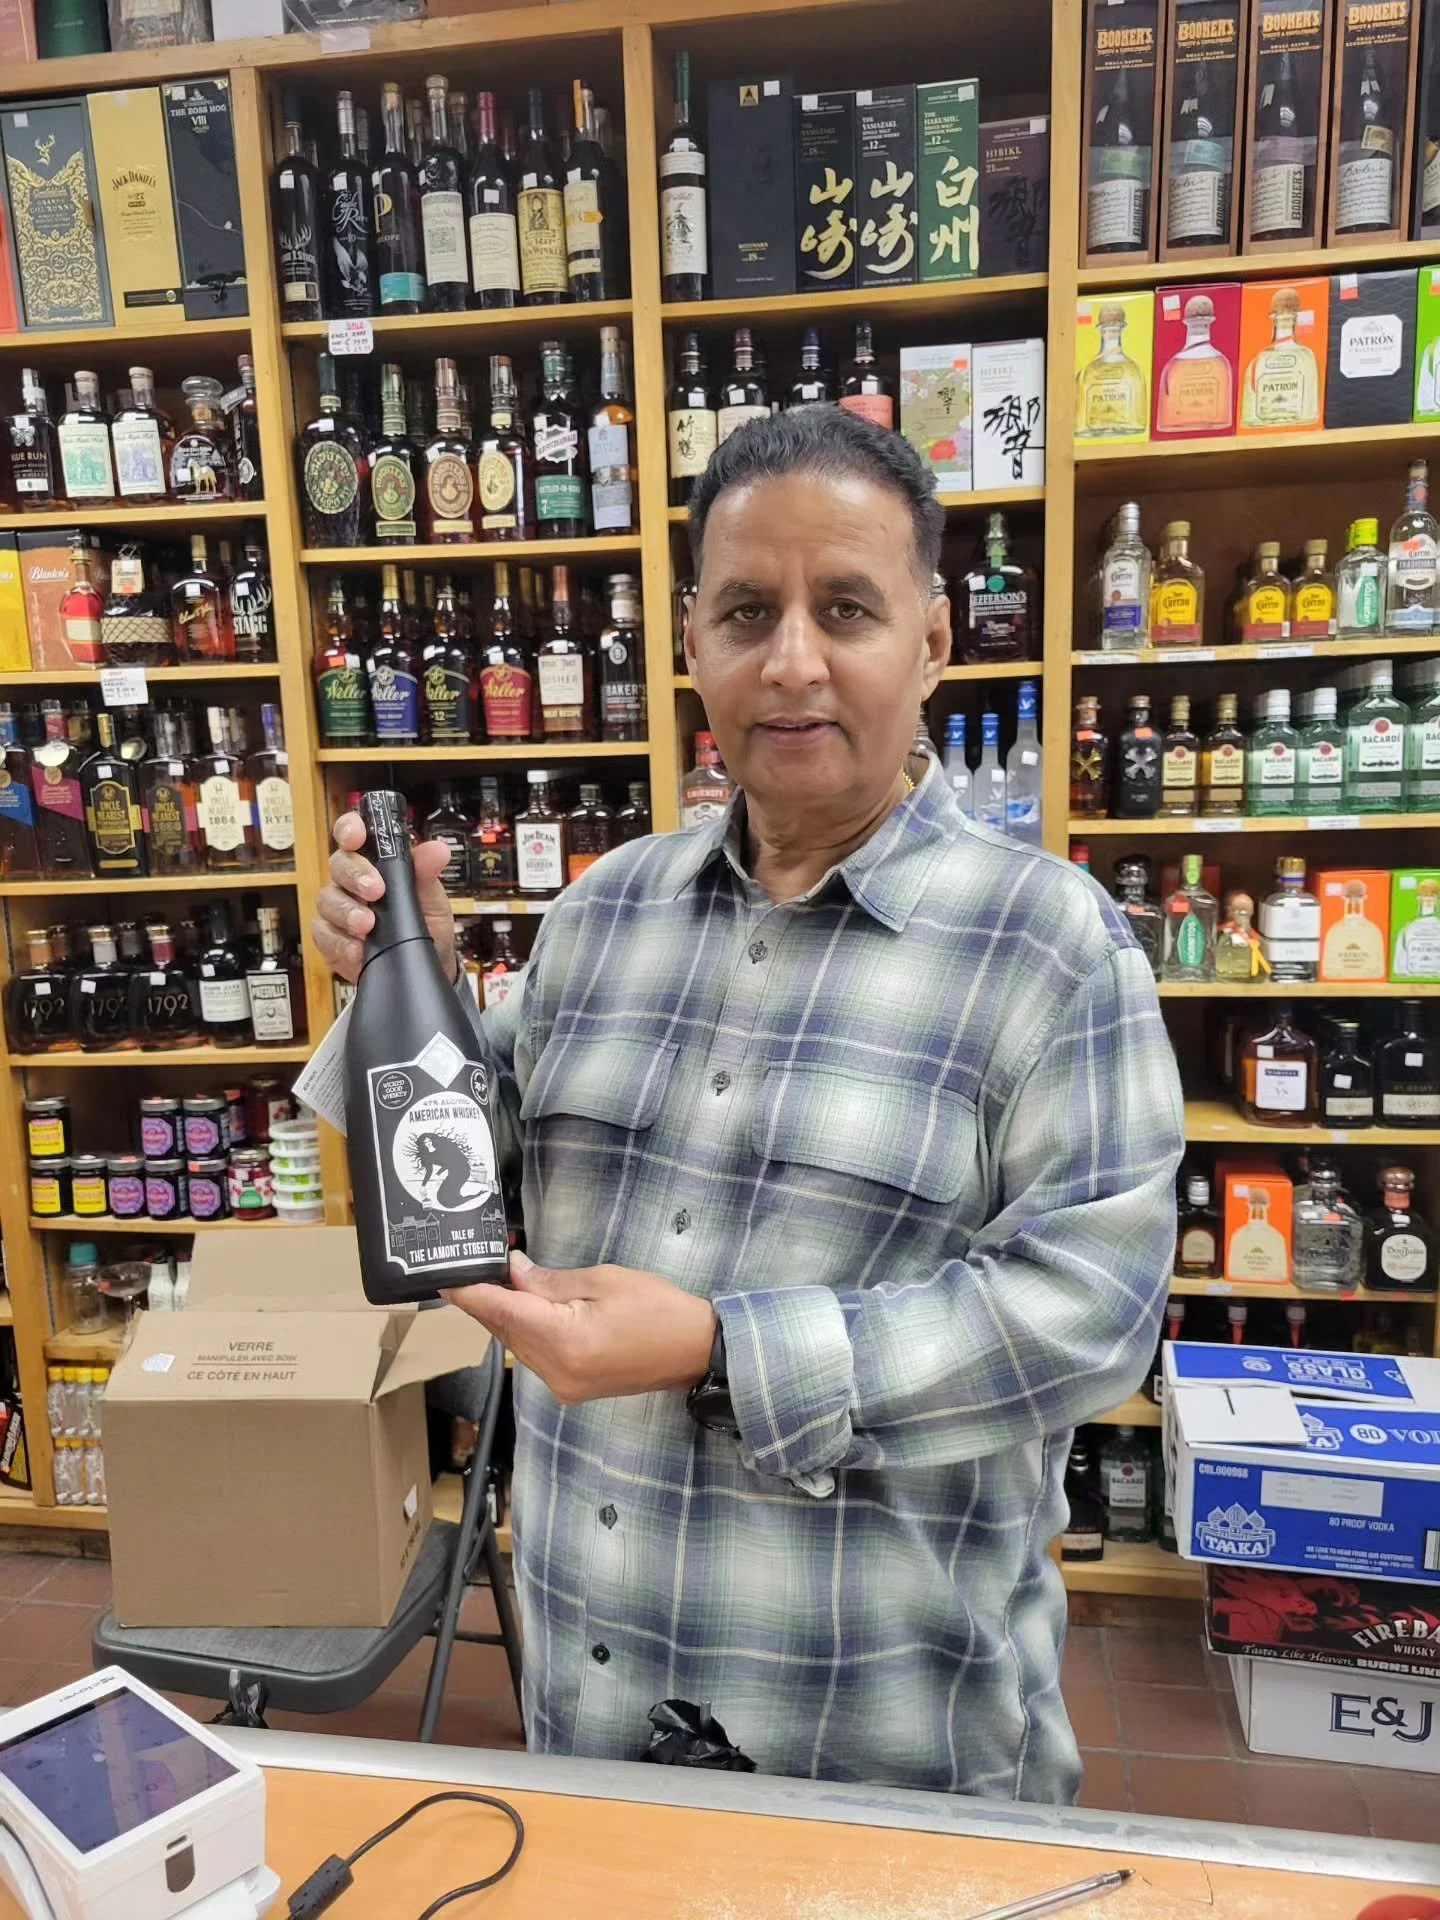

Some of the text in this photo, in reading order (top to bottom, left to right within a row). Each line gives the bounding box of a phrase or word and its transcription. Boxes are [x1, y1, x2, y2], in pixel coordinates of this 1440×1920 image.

[1263, 10, 1320, 32] BOOKER'S
[1349, 2, 1407, 25] BOOKER'S
[1178, 19, 1235, 41] BOOKER'S
[1097, 28, 1153, 49] BOOKER'S
[170, 109, 186, 117] THE
[209, 104, 227, 112] HOG
[191, 115, 207, 126] VIII
[862, 121, 896, 130] YAMAZAKI
[869, 141, 879, 149] 12
[931, 136, 941, 144] 12
[27, 452, 47, 461] RUN
[30, 566, 69, 579] Blanton's
[535, 830, 556, 845] BEAM
[23, 999, 65, 1018] 1792
[147, 994, 189, 1017] 1792
[385, 1086, 403, 1094] GOOD
[409, 1107, 480, 1123] AMERICAN WHISKEY
[451, 1229, 475, 1241] TALE OF
[409, 1249, 426, 1263] THE
[427, 1244, 460, 1261] LAMONT
[462, 1241, 489, 1256] STREET
[229, 1341, 275, 1351] VERRE
[187, 1371, 205, 1381] CE
[244, 1371, 261, 1381] EN
[263, 1371, 297, 1381] HAUT
[1287, 1362, 1366, 1380] GLASS
[1357, 1428, 1381, 1440] 80
[1329, 1517, 1395, 1532] 80 PROOF VODKA
[1205, 1535, 1265, 1555] TAAKA
[1241, 1644, 1279, 1657] Tastes
[1281, 1649, 1305, 1660] Like
[1357, 1658, 1409, 1672] BURNS
[1393, 1644, 1436, 1657] WHISKY
[1329, 1692, 1434, 1743] E&J
